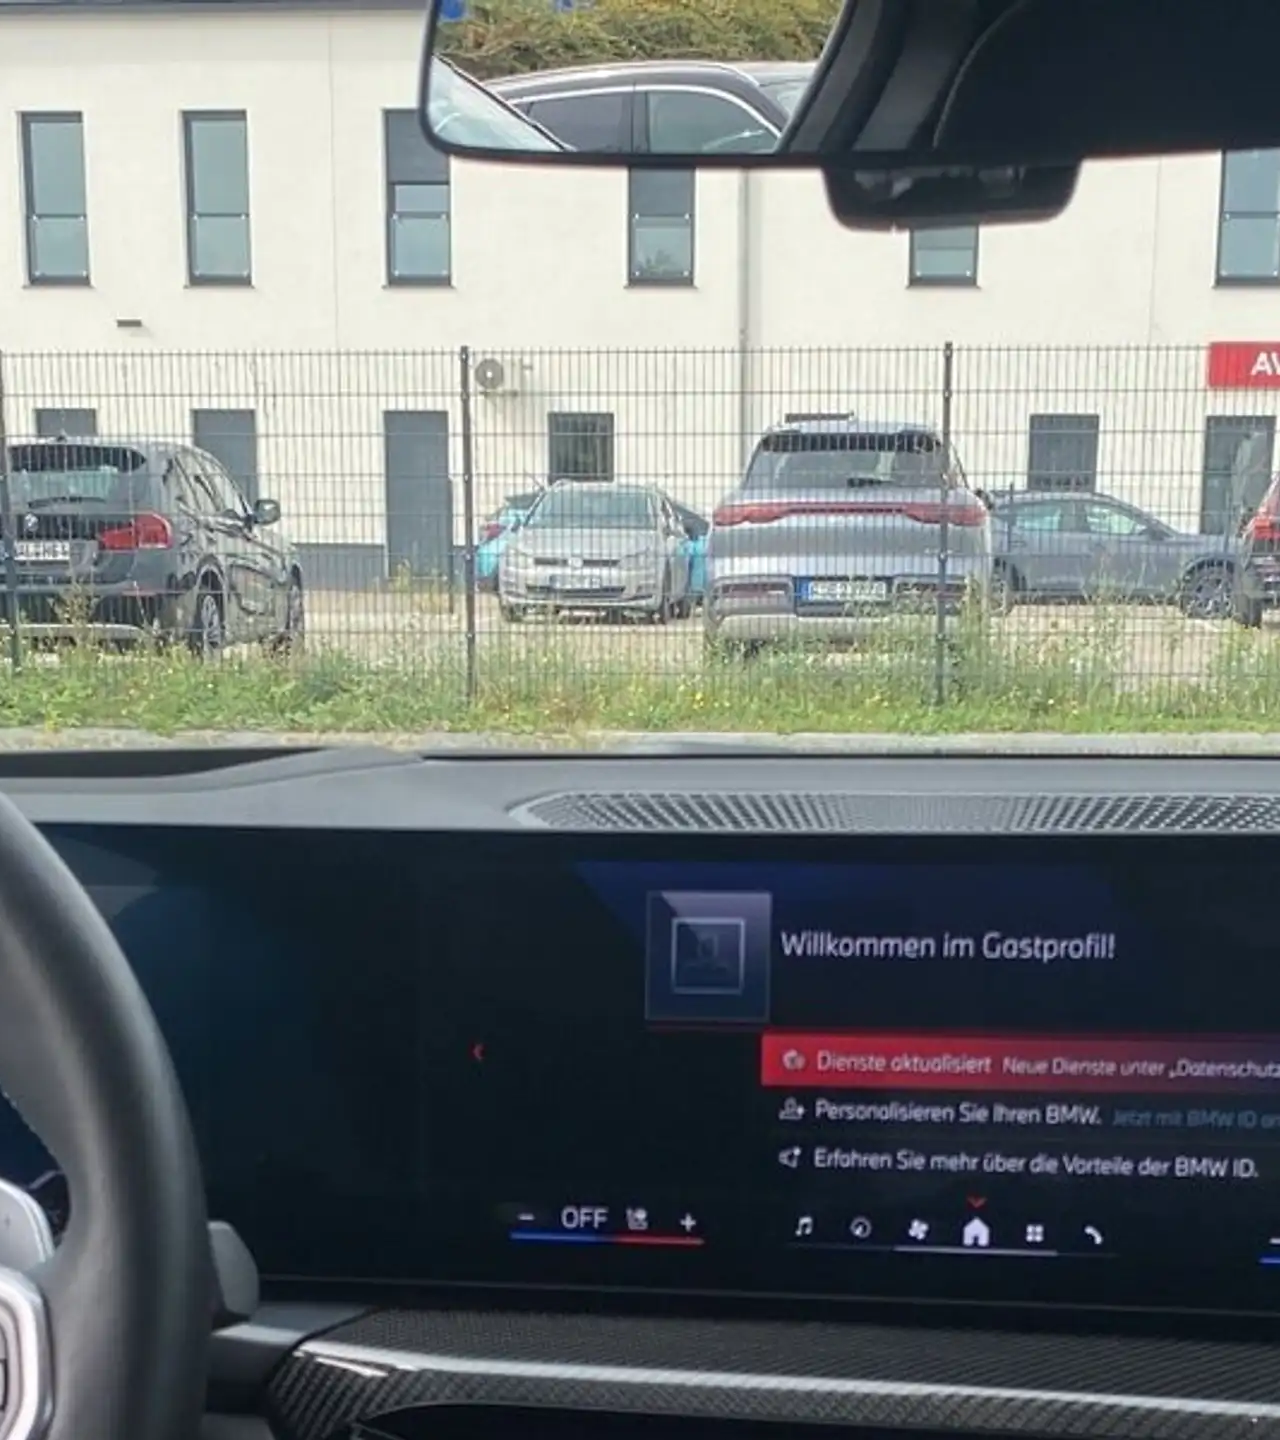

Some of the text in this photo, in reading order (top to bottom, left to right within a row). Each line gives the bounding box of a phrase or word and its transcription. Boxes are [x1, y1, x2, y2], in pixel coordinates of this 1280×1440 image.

[781, 930, 1116, 963] Willkommen im Gastprofil!
[817, 1050, 886, 1071] Dienste
[890, 1052, 992, 1074] aktualisiert
[1002, 1057, 1049, 1075] Neue
[1052, 1057, 1115, 1076] Dienste
[1120, 1059, 1165, 1077] unter
[815, 1099, 954, 1122] Personalisieren
[959, 1102, 990, 1123] Sie
[993, 1102, 1041, 1124] Ihren
[1046, 1104, 1102, 1125] BMW.
[1186, 1111, 1233, 1128] BMW
[1238, 1111, 1256, 1128] ID
[814, 1147, 1259, 1178] Erfahren Sie mehr über die Vorteile der BMW ID.
[561, 1205, 609, 1230] OFF
